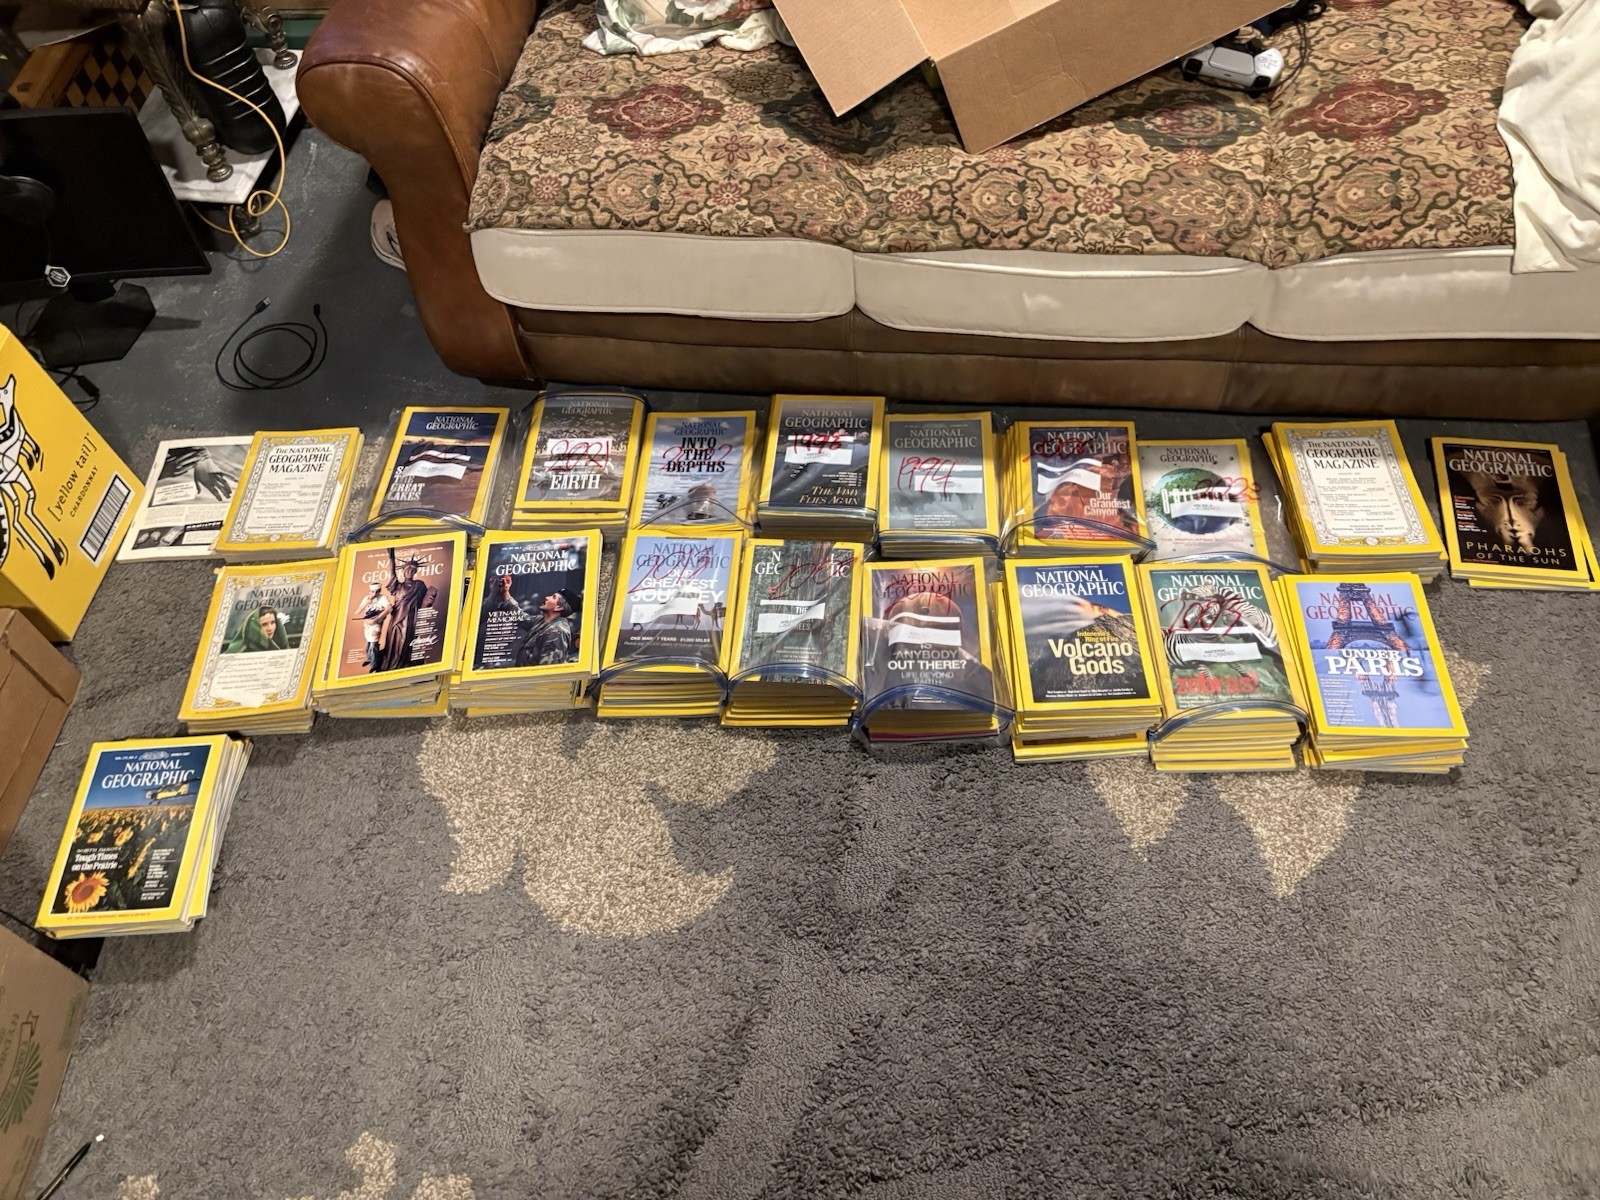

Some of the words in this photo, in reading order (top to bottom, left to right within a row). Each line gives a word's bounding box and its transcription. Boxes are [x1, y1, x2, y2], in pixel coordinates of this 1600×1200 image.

[562, 407, 614, 415] GEOGRAPHIC
[802, 408, 852, 418] NATIONAL
[426, 422, 478, 430] GEOGRAPHIC
[785, 417, 868, 428] GEOGRAPHIC
[674, 428, 727, 436] GEOGRAPHIC
[910, 428, 964, 437] NATIONAL
[1047, 430, 1110, 442] NATIONAL
[682, 436, 717, 448] INTO
[894, 436, 978, 448] GEOGRAPHIC
[1032, 441, 1128, 454] GEOGRAPHIC
[1323, 440, 1374, 448] NATIONAL
[288, 446, 332, 454] NATIONAL
[683, 448, 714, 460] THE
[1306, 448, 1381, 458] GEOGRAPHIC
[268, 453, 332, 464] GEOGRAPHIC
[1160, 454, 1218, 464] GEOGRAPHIC
[1463, 449, 1536, 464] NATIONAL
[268, 463, 326, 474] MAGAZINE
[666, 460, 726, 473] DEPTHS
[1314, 459, 1380, 469] MAGAZINE
[1449, 458, 1553, 478] GEOGRAPHIC
[390, 482, 425, 492] GREAT
[550, 474, 601, 490] EARTH
[70, 465, 99, 518] CHARDONNAY
[387, 492, 422, 500] LAKES
[1089, 498, 1131, 509] Grandest
[1084, 506, 1118, 516] Canyon
[652, 542, 716, 556] NATIONAL
[1466, 541, 1568, 558] PHARAOHS
[510, 550, 568, 563] NATIONAL
[636, 554, 730, 569] GEOGRAPHIC
[1476, 552, 1492, 560] OF
[1500, 554, 1525, 564] THE
[1532, 556, 1560, 566] SUN
[495, 560, 577, 576] GEOGRAPHIC
[891, 572, 959, 585] NATIONAL
[1035, 569, 1108, 584] NATIONAL
[1170, 574, 1245, 588] NATIONAL
[641, 577, 718, 590] GREATEST
[250, 586, 302, 598] NATIONAL
[630, 588, 724, 604] JOUEY
[1021, 582, 1126, 598] GEOGRAPHIC
[235, 596, 308, 611] GEOGRAPHIC
[486, 616, 526, 624] MEMORIAL
[1048, 638, 1134, 658] Volcano
[894, 650, 958, 660] ANYBODY
[1341, 648, 1402, 661] UNDER
[888, 660, 916, 670] OUT
[917, 660, 968, 670] THERE?
[1069, 656, 1126, 676] Gods
[1324, 656, 1424, 677] PARIS
[124, 759, 182, 772] NATIONAL
[102, 770, 195, 789] GEOGRAPHIC
[74, 852, 97, 862] Tough
[98, 852, 118, 860] Times
[81, 862, 92, 870] the
[92, 862, 118, 870] Prairie
